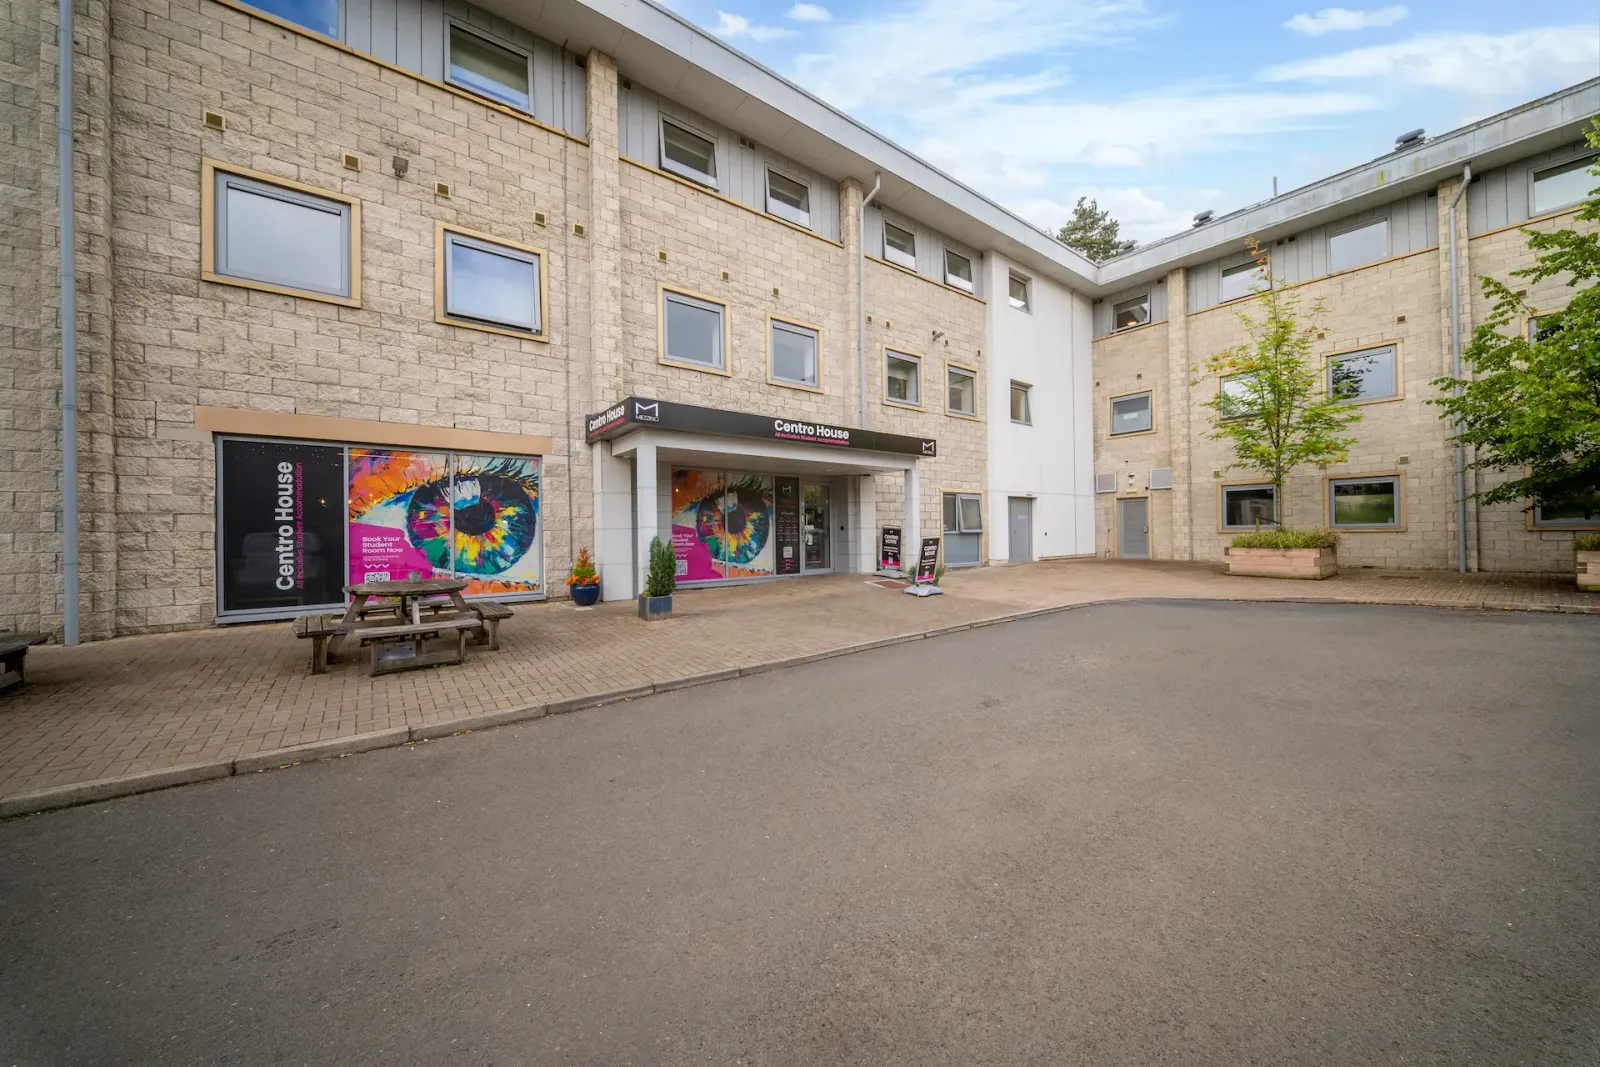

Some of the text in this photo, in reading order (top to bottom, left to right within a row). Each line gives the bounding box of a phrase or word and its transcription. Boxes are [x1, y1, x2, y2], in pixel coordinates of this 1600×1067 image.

[589, 415, 606, 431] Centro
[606, 404, 625, 422] House
[635, 414, 660, 423] MEZZINO
[774, 419, 850, 440] Centro House
[275, 461, 294, 590] Centro House
[295, 462, 304, 589] All Inclusive Student Accommodation
